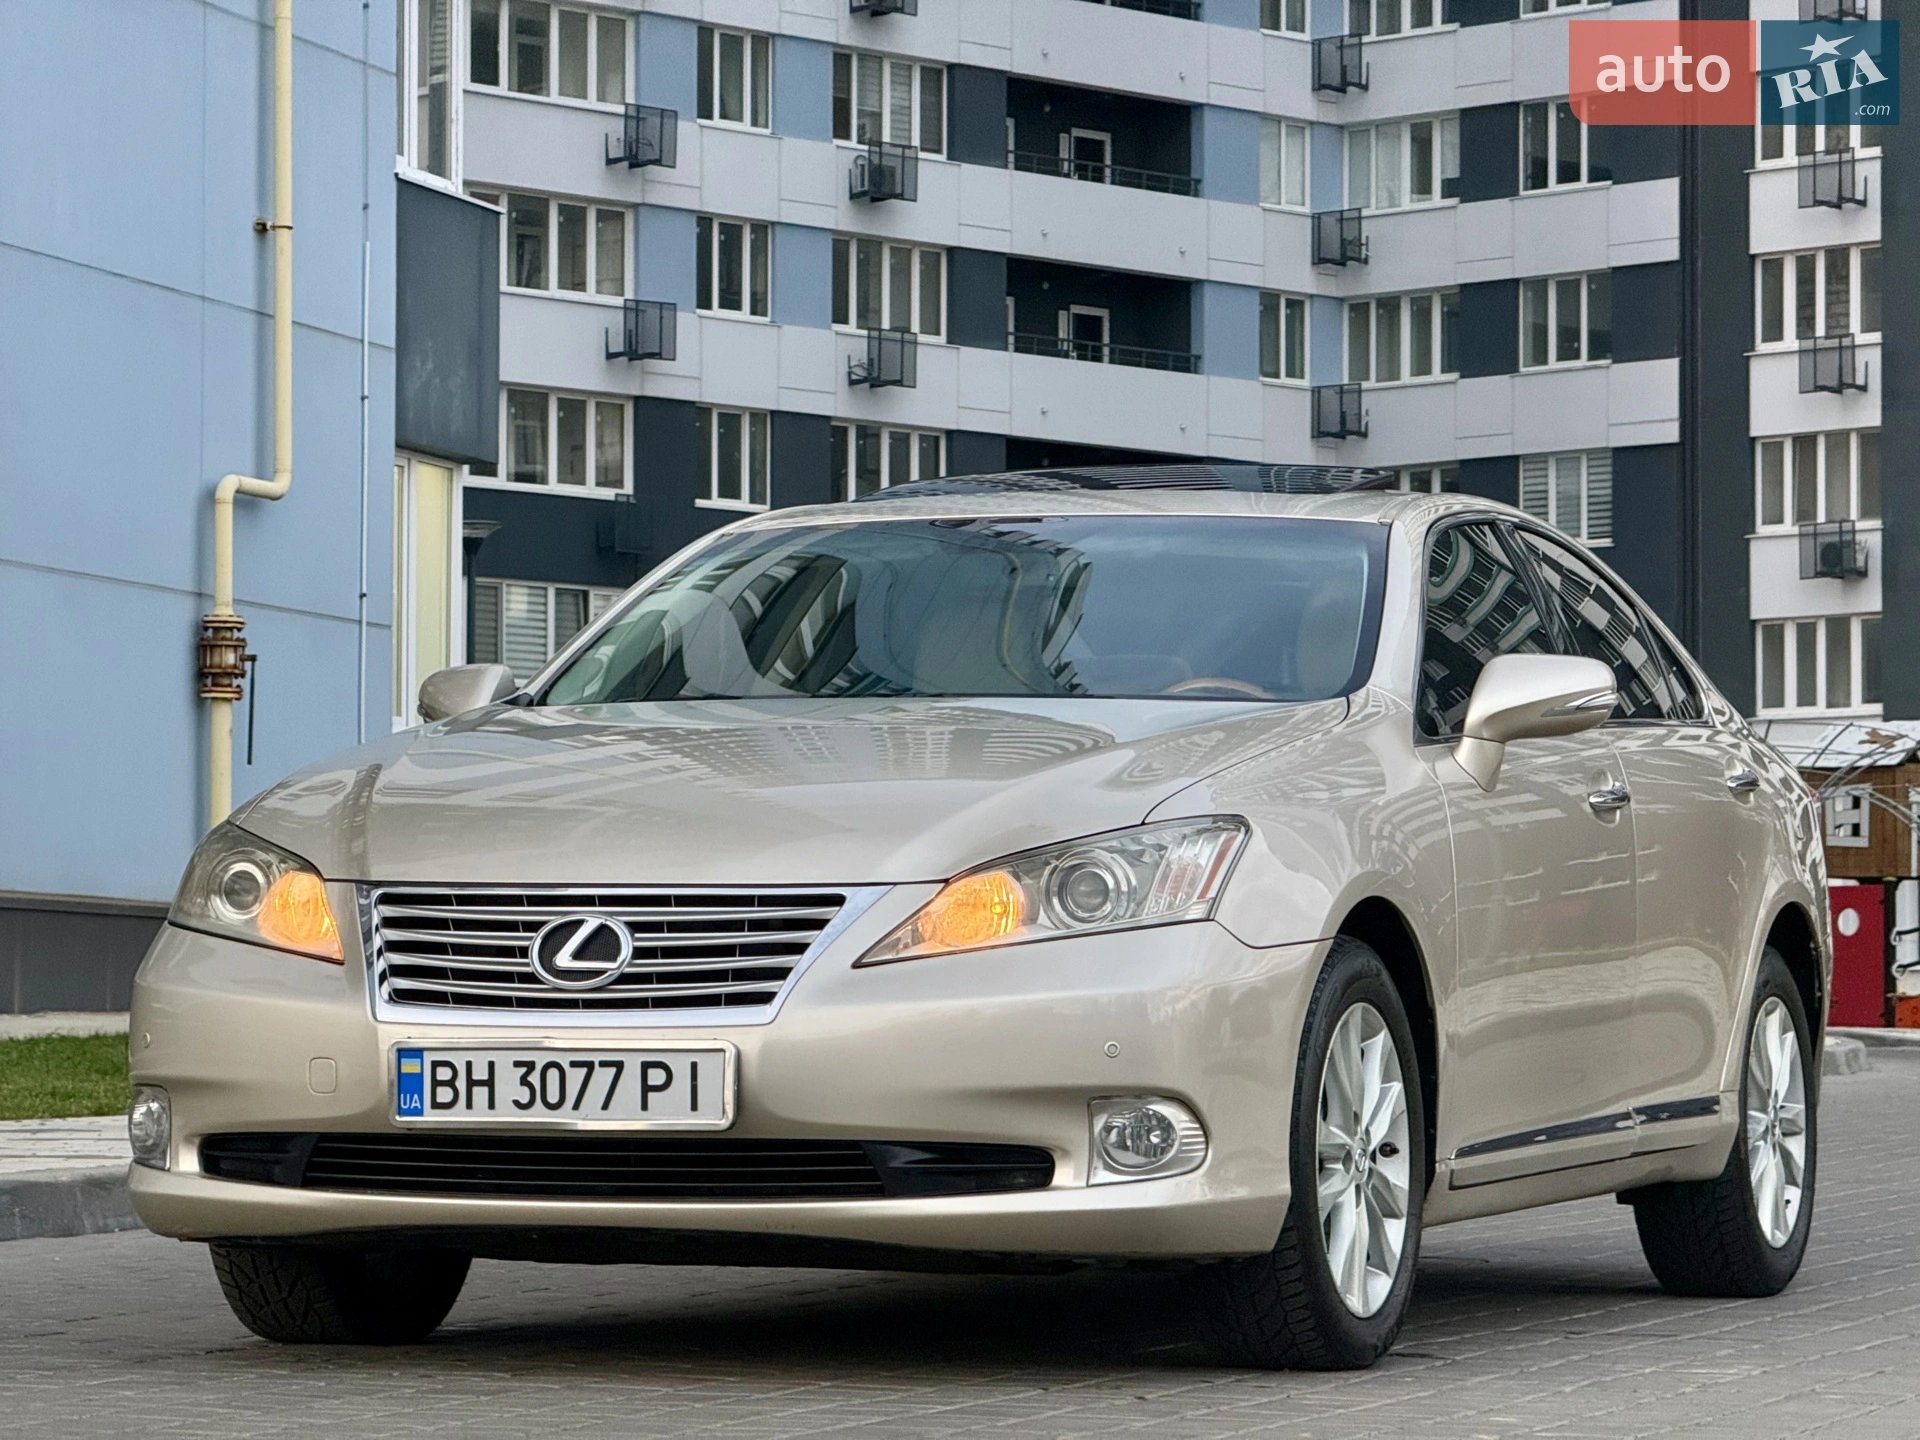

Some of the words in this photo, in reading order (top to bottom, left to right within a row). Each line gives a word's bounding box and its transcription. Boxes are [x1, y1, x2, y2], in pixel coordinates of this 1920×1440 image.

[400, 1093, 421, 1110] UA
[430, 1059, 496, 1111] BH
[511, 1059, 625, 1112] 3077
